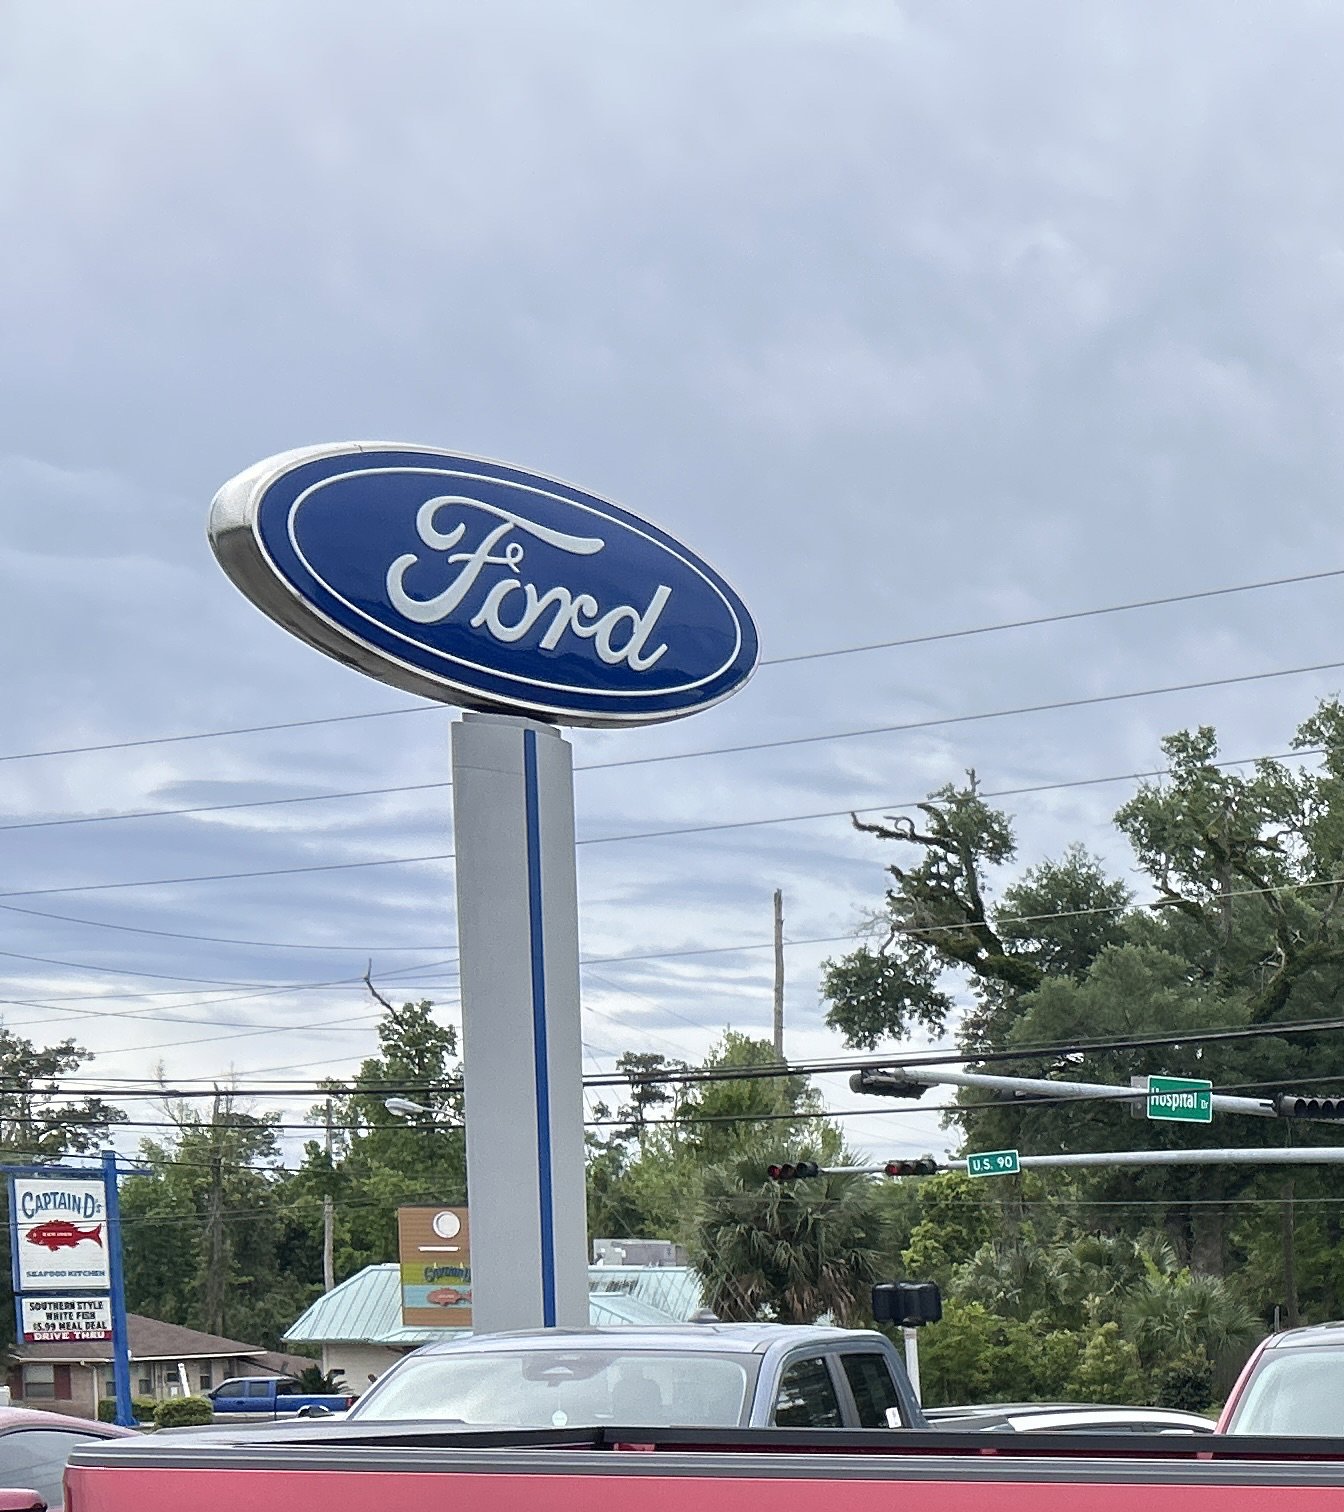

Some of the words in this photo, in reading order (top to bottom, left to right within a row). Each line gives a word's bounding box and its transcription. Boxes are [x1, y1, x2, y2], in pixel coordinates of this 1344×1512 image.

[387, 496, 672, 671] Ford
[1150, 1087, 1198, 1111] Hospital
[1200, 1099, 1209, 1109] Dr
[973, 1159, 993, 1171] U.S.
[997, 1156, 1013, 1168] 90
[22, 1191, 81, 1219] CAPTAIN
[26, 1270, 67, 1278] SEAFOOD
[29, 1301, 75, 1311] SOUTHERN
[76, 1301, 103, 1310] STYLE
[45, 1311, 74, 1321] WHITE
[76, 1311, 96, 1320] FISH
[58, 1321, 84, 1331] MEAL
[85, 1320, 108, 1330] DEAL
[33, 1331, 70, 1341] DRIVE
[73, 1331, 105, 1339] THRU
